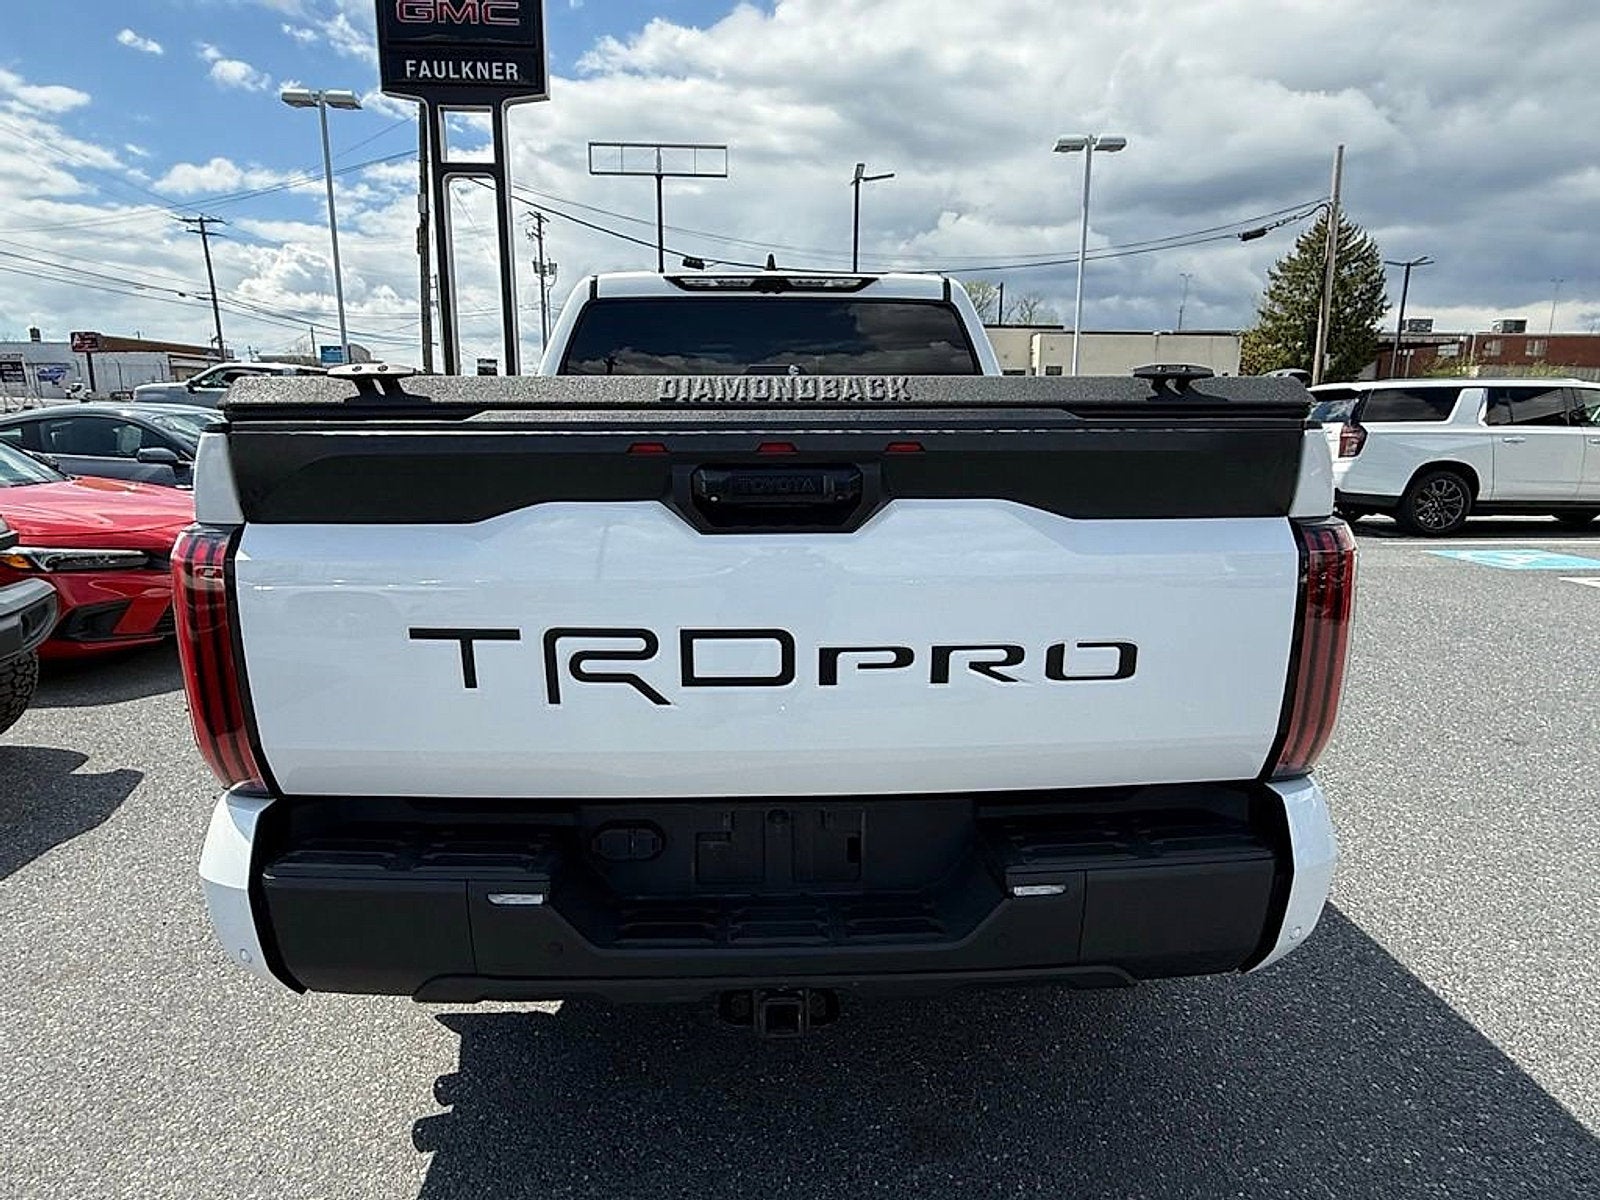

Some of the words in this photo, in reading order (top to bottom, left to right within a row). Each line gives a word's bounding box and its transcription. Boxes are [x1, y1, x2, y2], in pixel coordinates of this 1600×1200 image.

[396, 0, 520, 25] GMC
[405, 59, 519, 81] FAULKNER
[658, 375, 913, 402] DIAMONDBACK
[408, 627, 796, 705] TRD
[818, 641, 1138, 686] PRO
